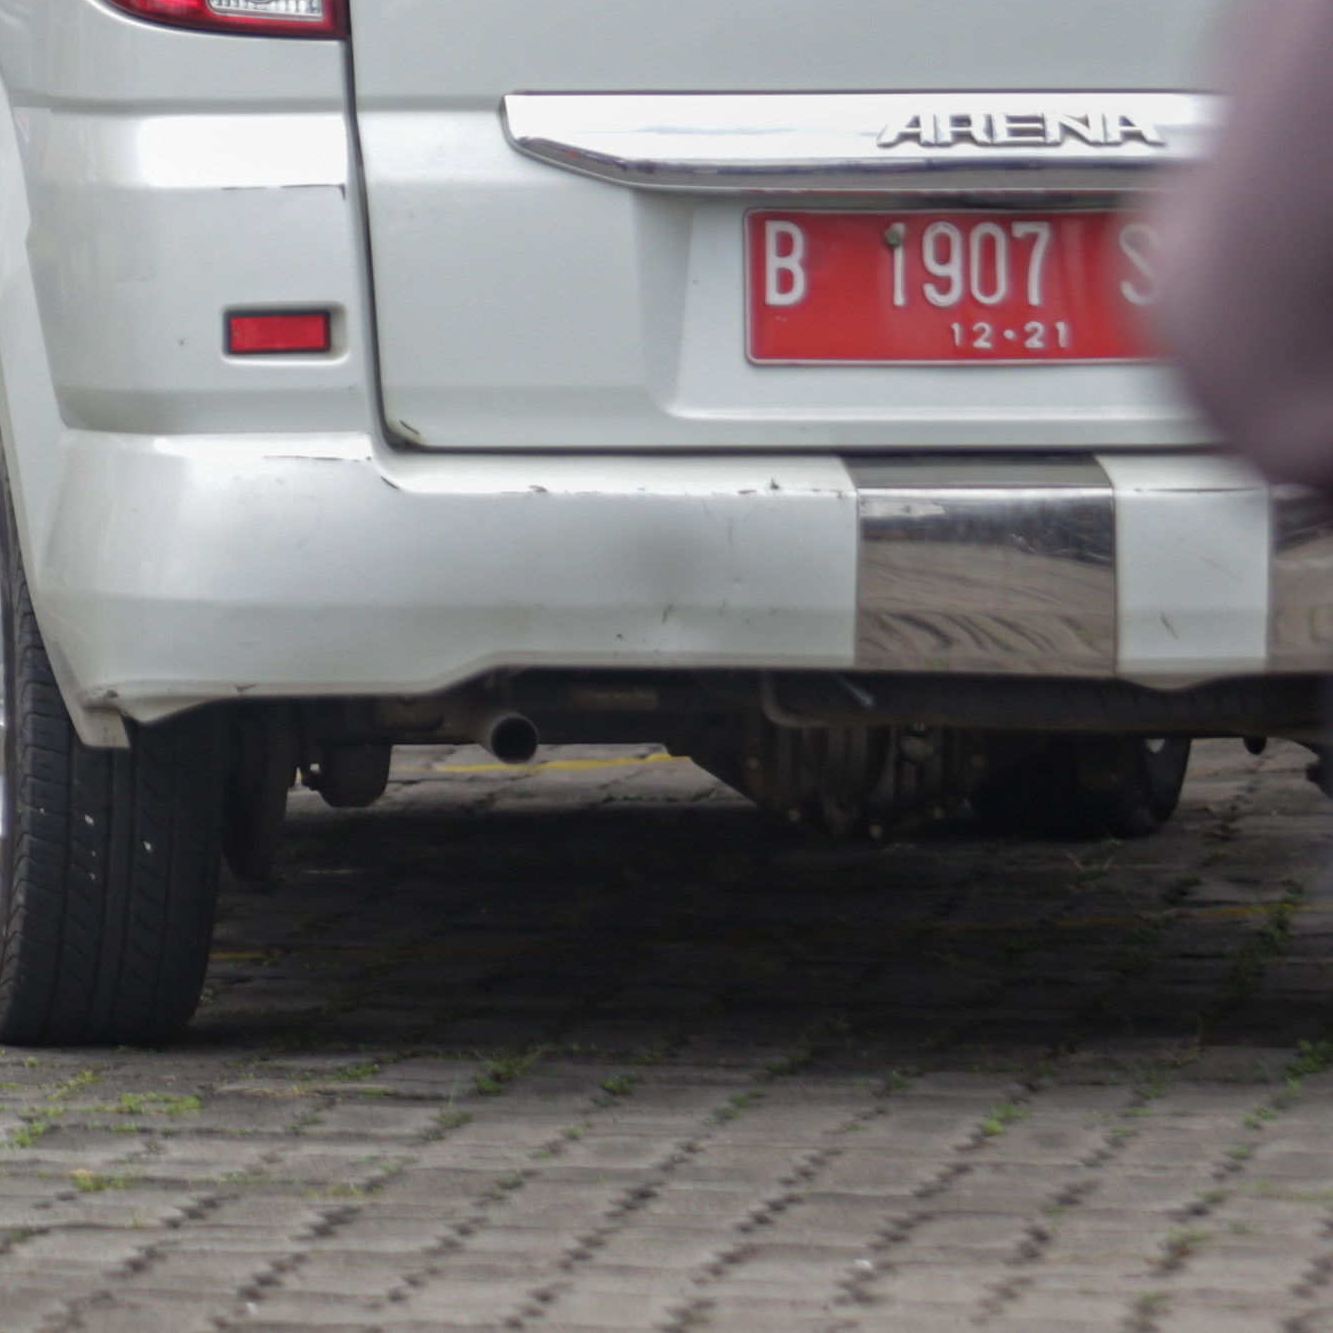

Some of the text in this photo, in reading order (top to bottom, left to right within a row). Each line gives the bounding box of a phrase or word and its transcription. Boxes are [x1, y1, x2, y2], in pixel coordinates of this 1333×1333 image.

[876, 111, 1167, 148] ARENA
[764, 220, 806, 307] B
[886, 221, 1051, 307] 1907
